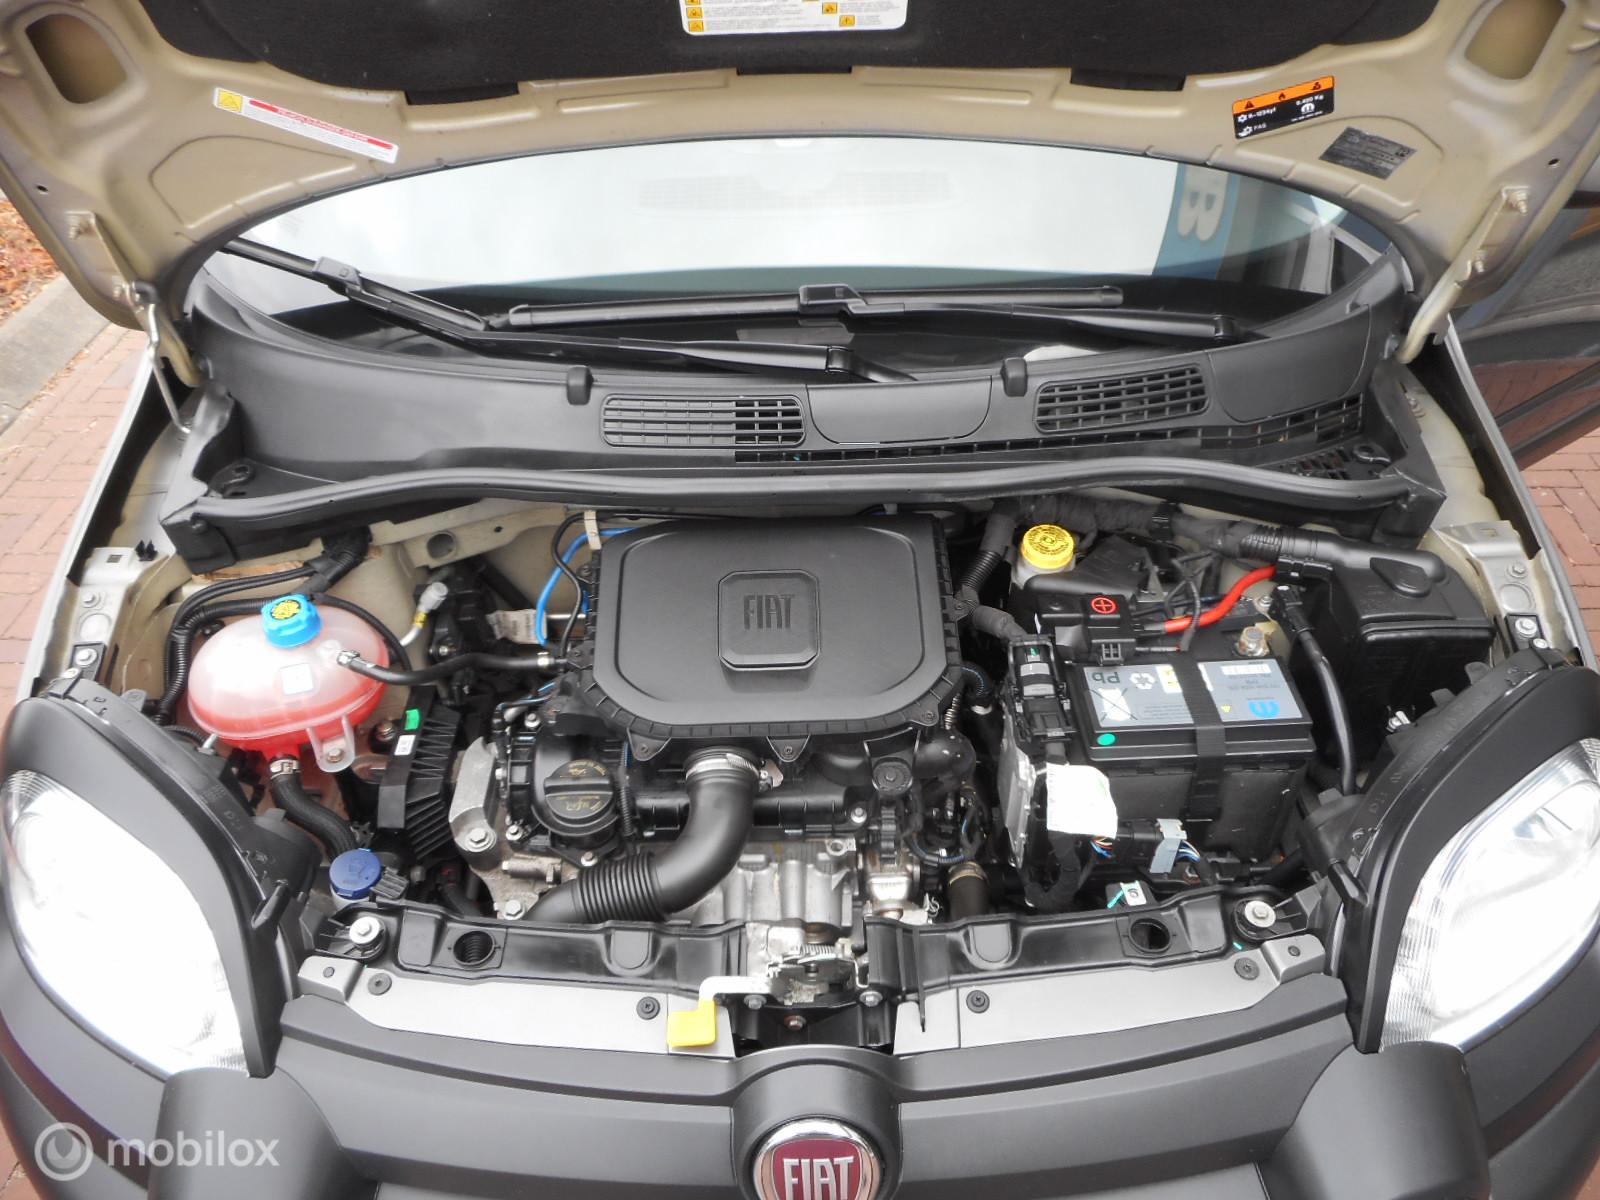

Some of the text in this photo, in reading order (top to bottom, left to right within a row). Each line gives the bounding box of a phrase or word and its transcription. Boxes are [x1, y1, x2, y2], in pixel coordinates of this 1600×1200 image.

[743, 594, 795, 631] FIAT
[1091, 671, 1121, 684] Pb
[783, 1156, 855, 1200] FIAT
